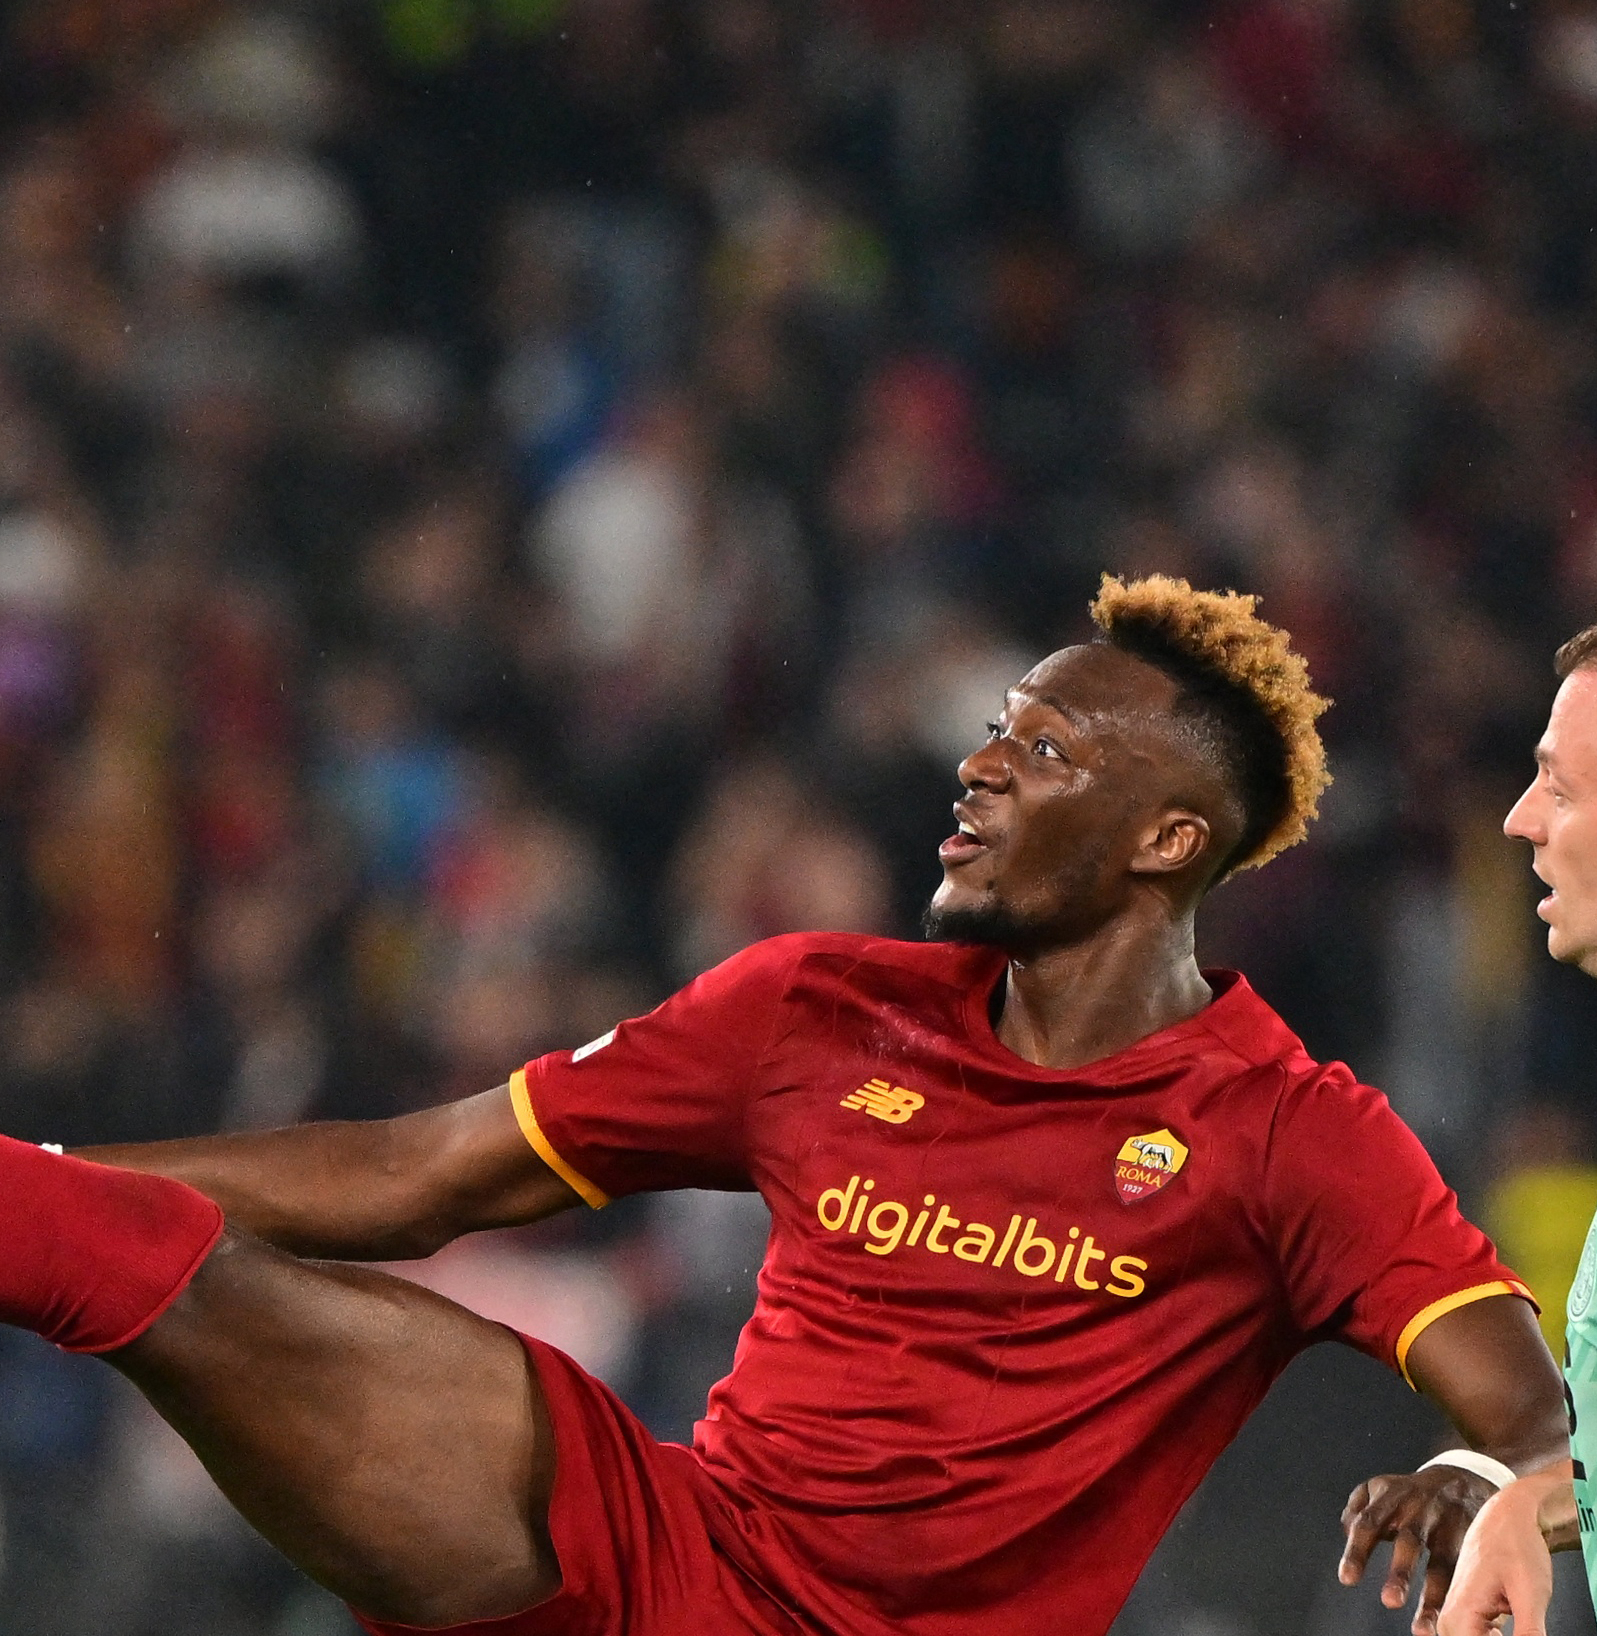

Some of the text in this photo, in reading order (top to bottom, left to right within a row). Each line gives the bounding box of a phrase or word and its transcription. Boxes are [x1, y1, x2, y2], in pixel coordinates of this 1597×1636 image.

[1115, 1165, 1163, 1189] ROMA
[1122, 1183, 1144, 1195] 1927
[816, 1175, 1149, 1298] digitalbits
